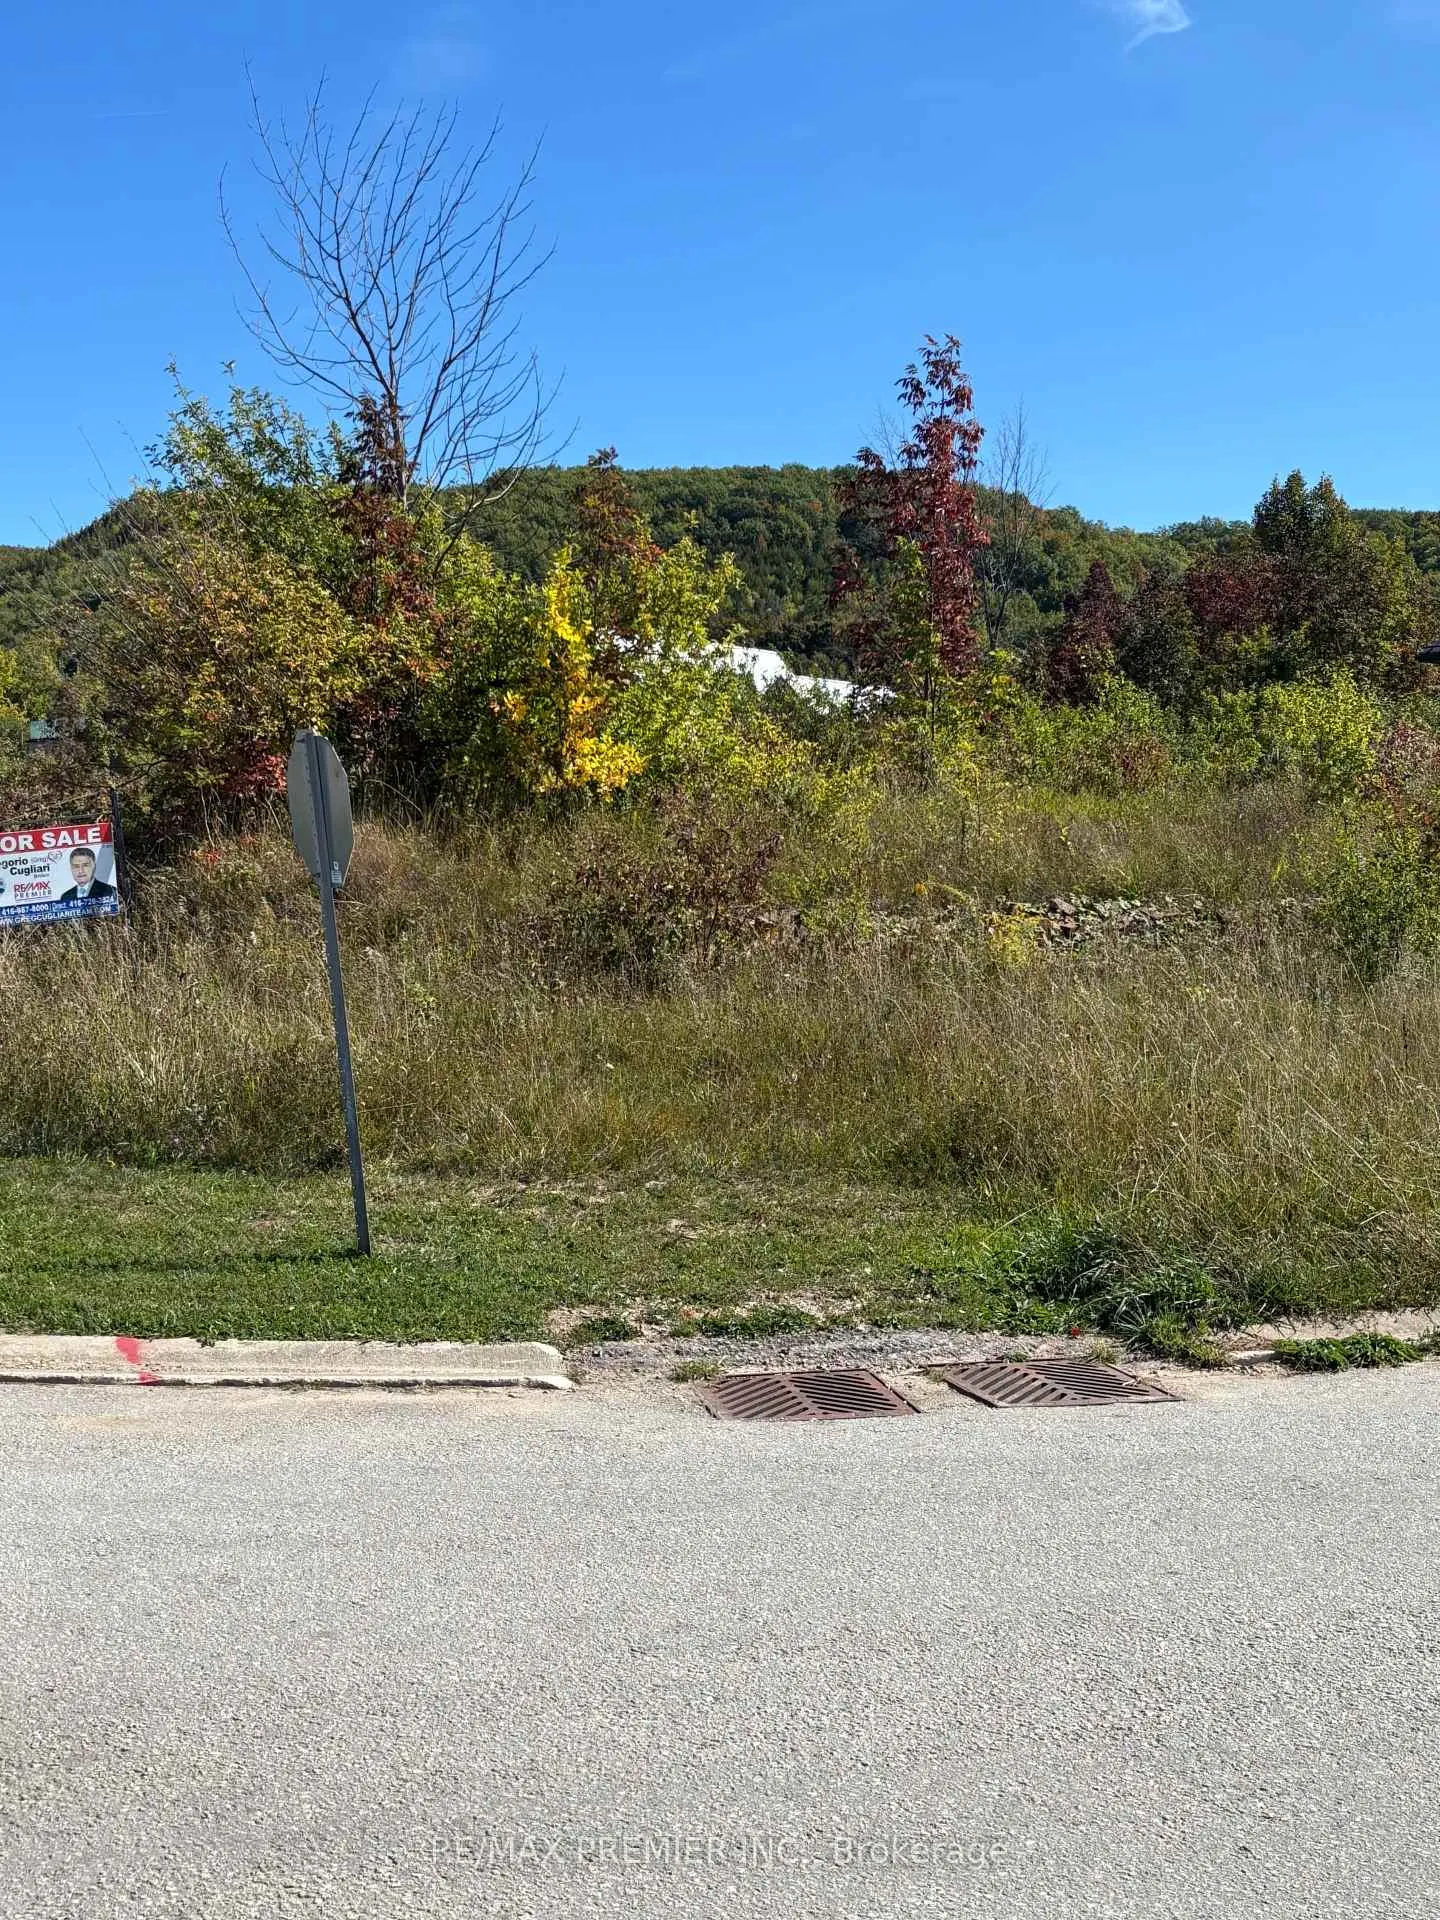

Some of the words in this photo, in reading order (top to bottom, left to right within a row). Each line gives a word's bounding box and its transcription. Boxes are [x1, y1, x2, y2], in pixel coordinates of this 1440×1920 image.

[41, 826, 102, 848] SALE
[0, 856, 29, 869] gorio
[14, 881, 51, 893] RE/MAX
